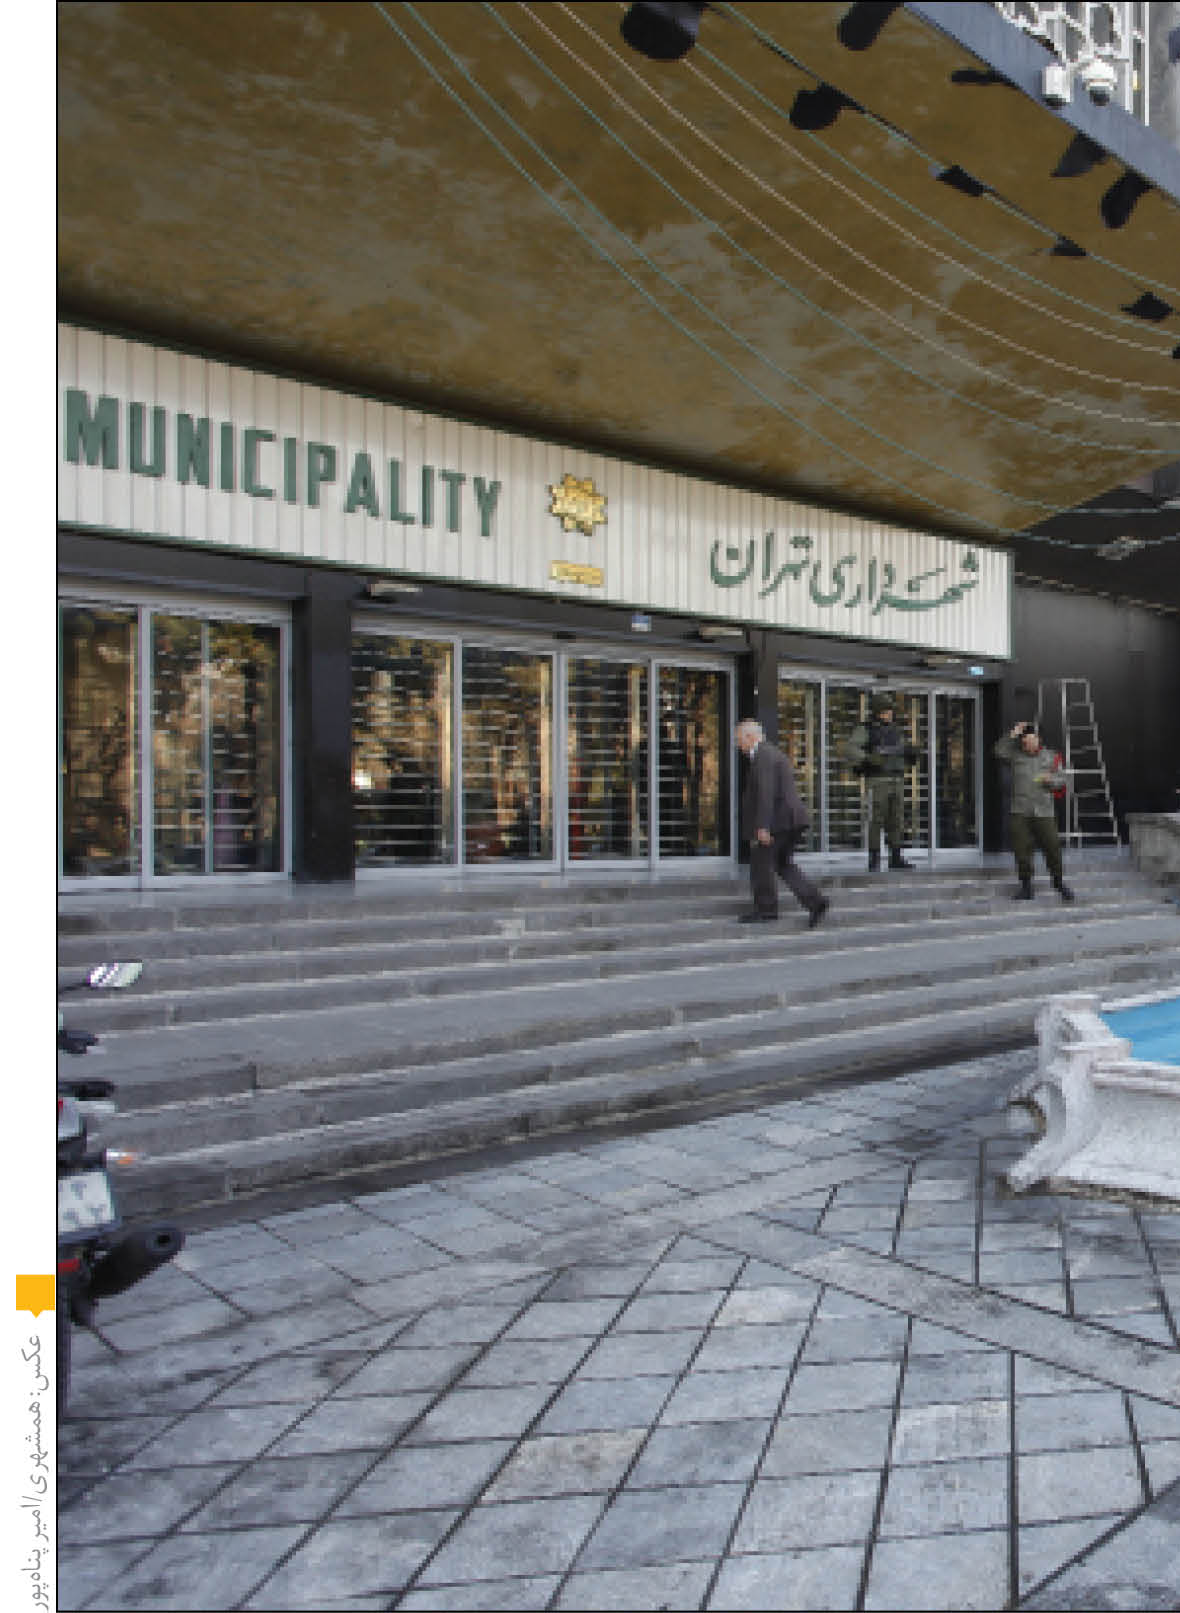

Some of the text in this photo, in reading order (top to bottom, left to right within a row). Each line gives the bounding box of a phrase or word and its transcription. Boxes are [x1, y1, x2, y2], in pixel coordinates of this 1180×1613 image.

[64, 388, 502, 536] MUNICIPALITY
[709, 530, 980, 616] شهرداری تهران
